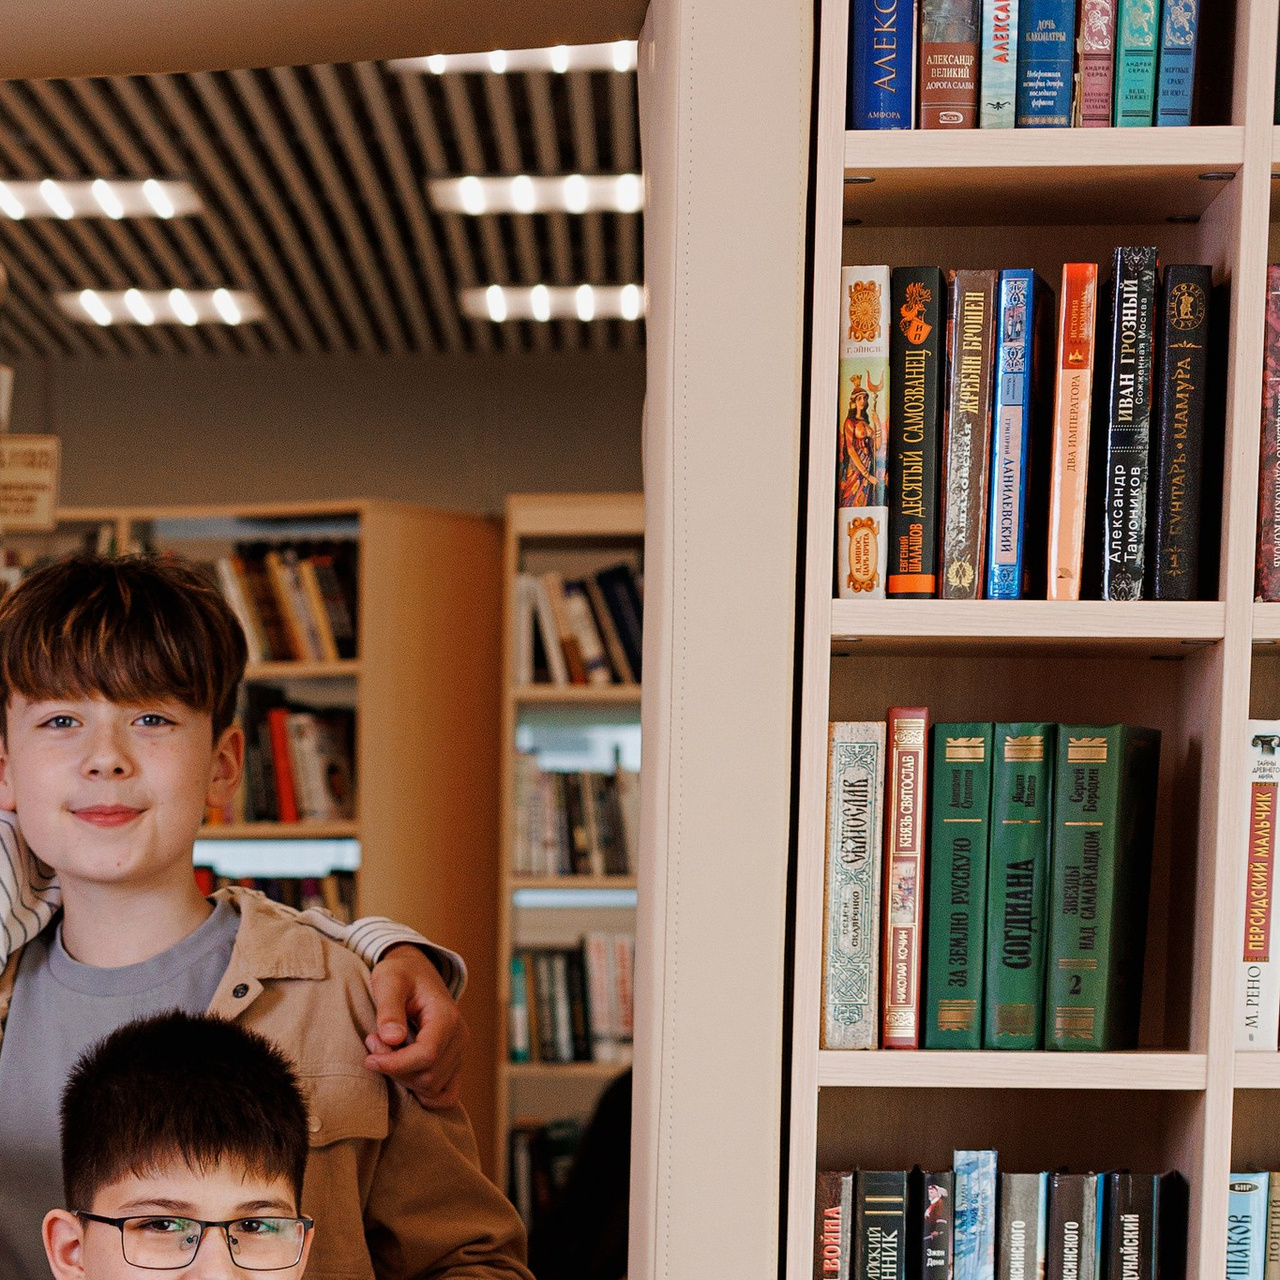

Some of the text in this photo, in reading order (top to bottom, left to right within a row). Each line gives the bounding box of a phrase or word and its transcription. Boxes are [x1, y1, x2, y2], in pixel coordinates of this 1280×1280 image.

[926, 55, 974, 66] АЛЕКСАНДР
[926, 82, 951, 90] ДОРОГА
[931, 67, 970, 78] ВЕЛИКИЙ
[963, 291, 984, 351] БРОШЕН
[1070, 299, 1079, 339] ИСТОРИЯ
[1117, 279, 1139, 422] ИВАН ГРОЗНЫЙ
[1135, 297, 1148, 405] Сожженная Москва
[901, 348, 932, 518] ДЕСЯТЫЙ САМОЗВАНЕЦ
[1067, 374, 1080, 473] ДВА ИМПЕРАТОРА
[1173, 357, 1195, 440] МАМУРА
[1000, 457, 1016, 553] ДАНИЛЕВСКИЙ
[1109, 464, 1127, 564] Александр
[1124, 466, 1140, 563] Тамоников
[899, 534, 908, 573] ЕВГЕНИЙ
[909, 522, 923, 573] ШАЛАШОВ
[900, 755, 915, 849] КНЯЗЬ СВЯТОСЛАВ
[1070, 768, 1087, 804] Сергей
[1083, 768, 1101, 813] Бородин
[1062, 865, 1080, 915] ЗВЕЗДЫ
[1079, 830, 1101, 951] НАД САМАРКАНДОМ
[1248, 791, 1272, 951] ПЕРСИДСКИЙ МАЛЬЧИК
[948, 837, 971, 988] ЗА ЗЕМЛЮ РУССКУЮ
[1002, 857, 1038, 970] СОГДИАНА
[896, 929, 908, 1004] НИКОЛАЙ КОЧИН
[1069, 975, 1081, 995] 2
[1246, 965, 1262, 1029] М. РЕНО
[823, 1206, 842, 1274] ВОЙНА
